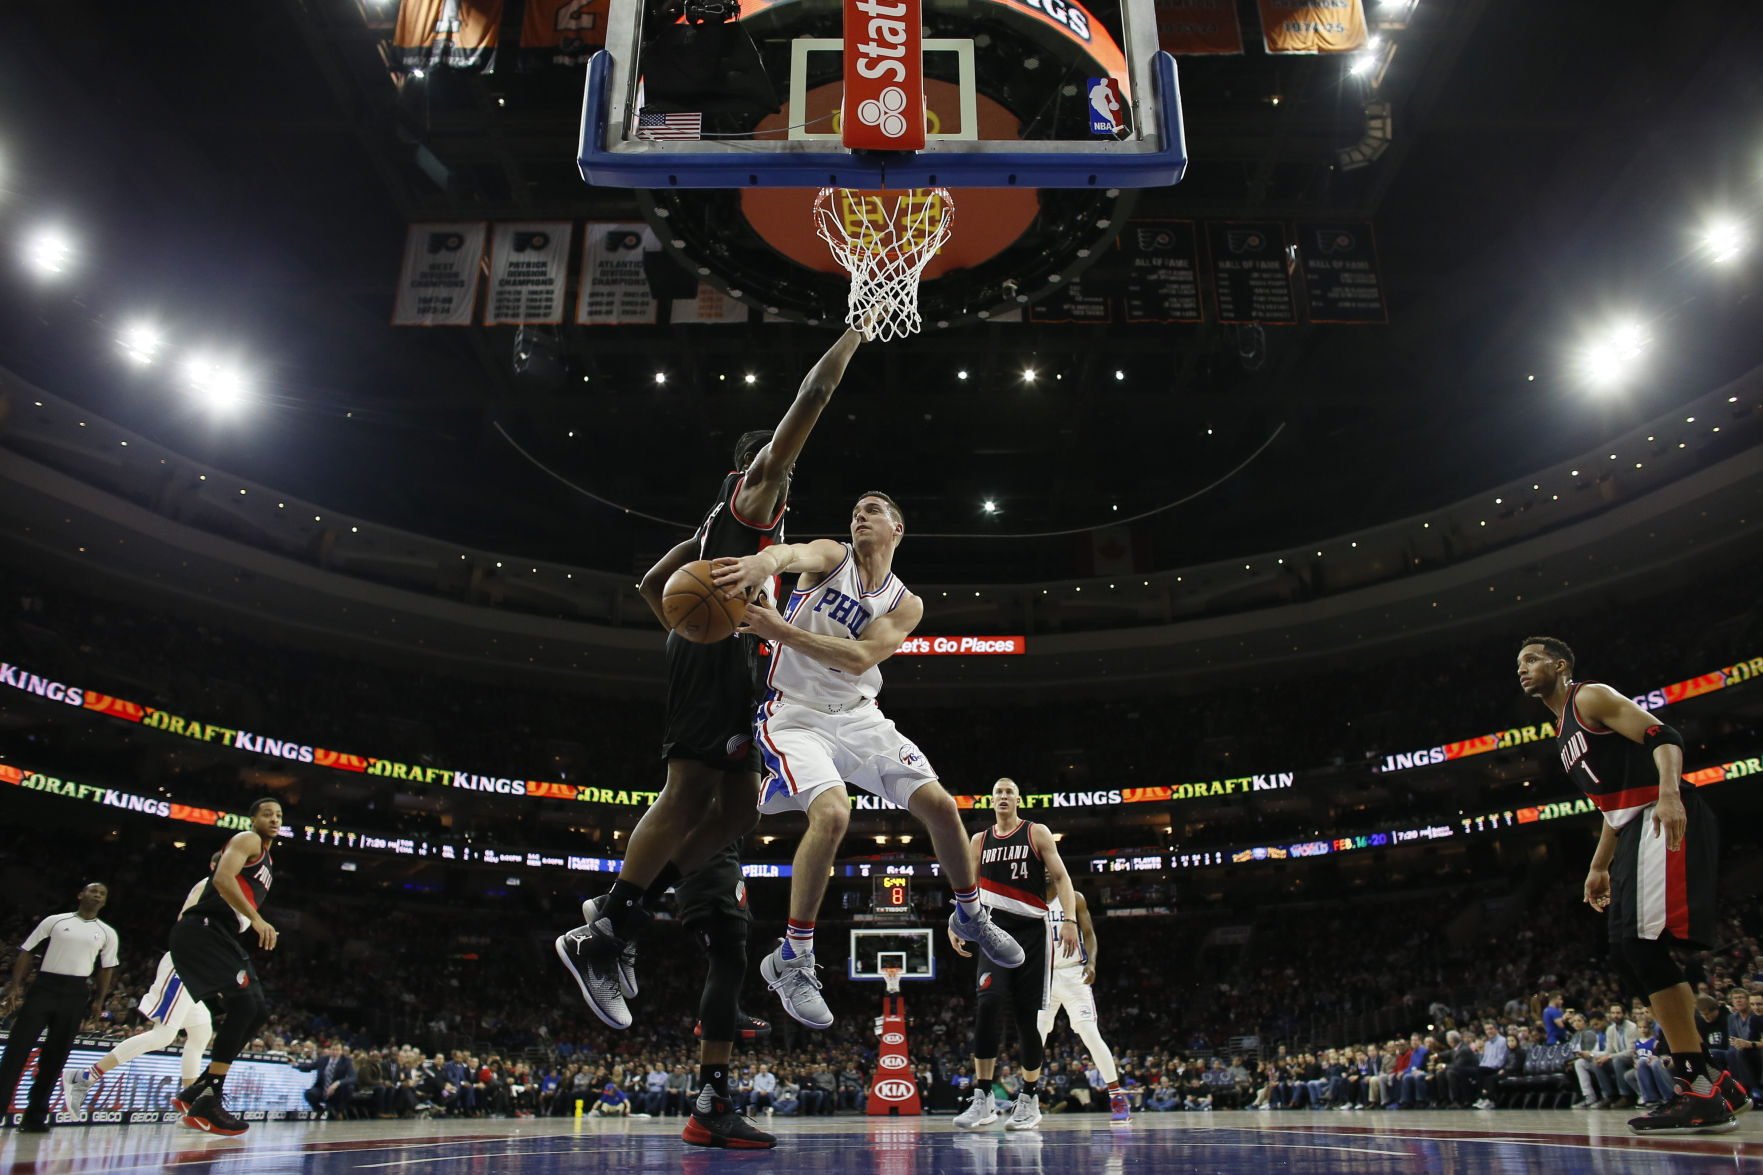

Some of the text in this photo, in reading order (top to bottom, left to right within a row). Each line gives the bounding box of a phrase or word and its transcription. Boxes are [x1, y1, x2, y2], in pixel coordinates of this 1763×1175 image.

[1094, 121, 1112, 131] NBA
[508, 261, 548, 269] PATRICK
[598, 260, 645, 268] ATLANTIC
[600, 269, 640, 277] DIVISION
[499, 279, 554, 287] CHAMPIONS
[591, 278, 647, 286] CHAMPIONS
[933, 637, 958, 653] Go
[960, 637, 1015, 653] Places
[143, 711, 314, 763] DRAFTKINGS
[367, 760, 527, 796] DRAFTKINGS
[1581, 760, 1600, 784] 1
[21, 773, 170, 818] DRAFTKINGS
[982, 845, 1029, 864] PORTLAND
[1133, 856, 1161, 864] PLAYER
[742, 864, 779, 878] PHILA
[1011, 861, 1028, 880] 24
[883, 877, 906, 888] 6:44
[892, 888, 903, 904] 8
[881, 1084, 908, 1096] KIA
[92, 1111, 122, 1122] GEICO
[130, 1112, 159, 1123] GEICO
